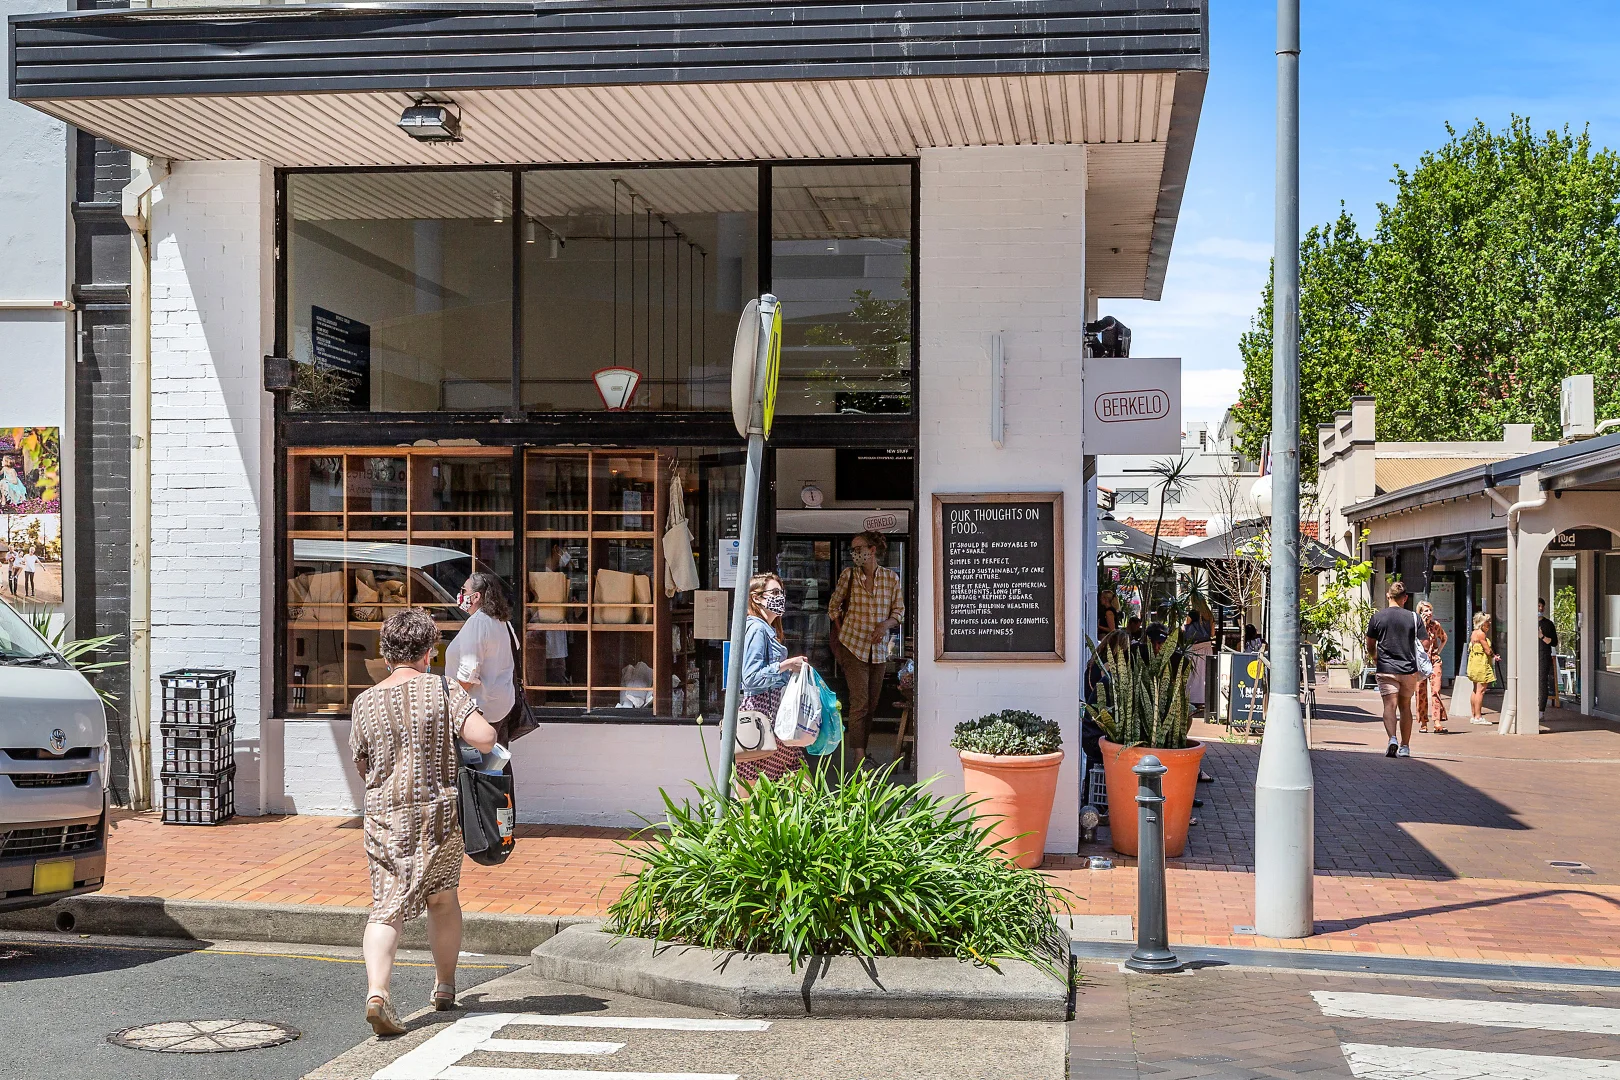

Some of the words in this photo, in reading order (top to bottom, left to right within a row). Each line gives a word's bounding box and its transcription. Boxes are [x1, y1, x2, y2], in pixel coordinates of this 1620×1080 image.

[1103, 395, 1161, 416] BERKELO
[951, 509, 970, 521] OUR
[974, 508, 1022, 521] THOUGHTS
[1025, 508, 1039, 520] ON
[866, 516, 893, 529] BERKELO
[977, 567, 1020, 575] SUSTAINABLY,
